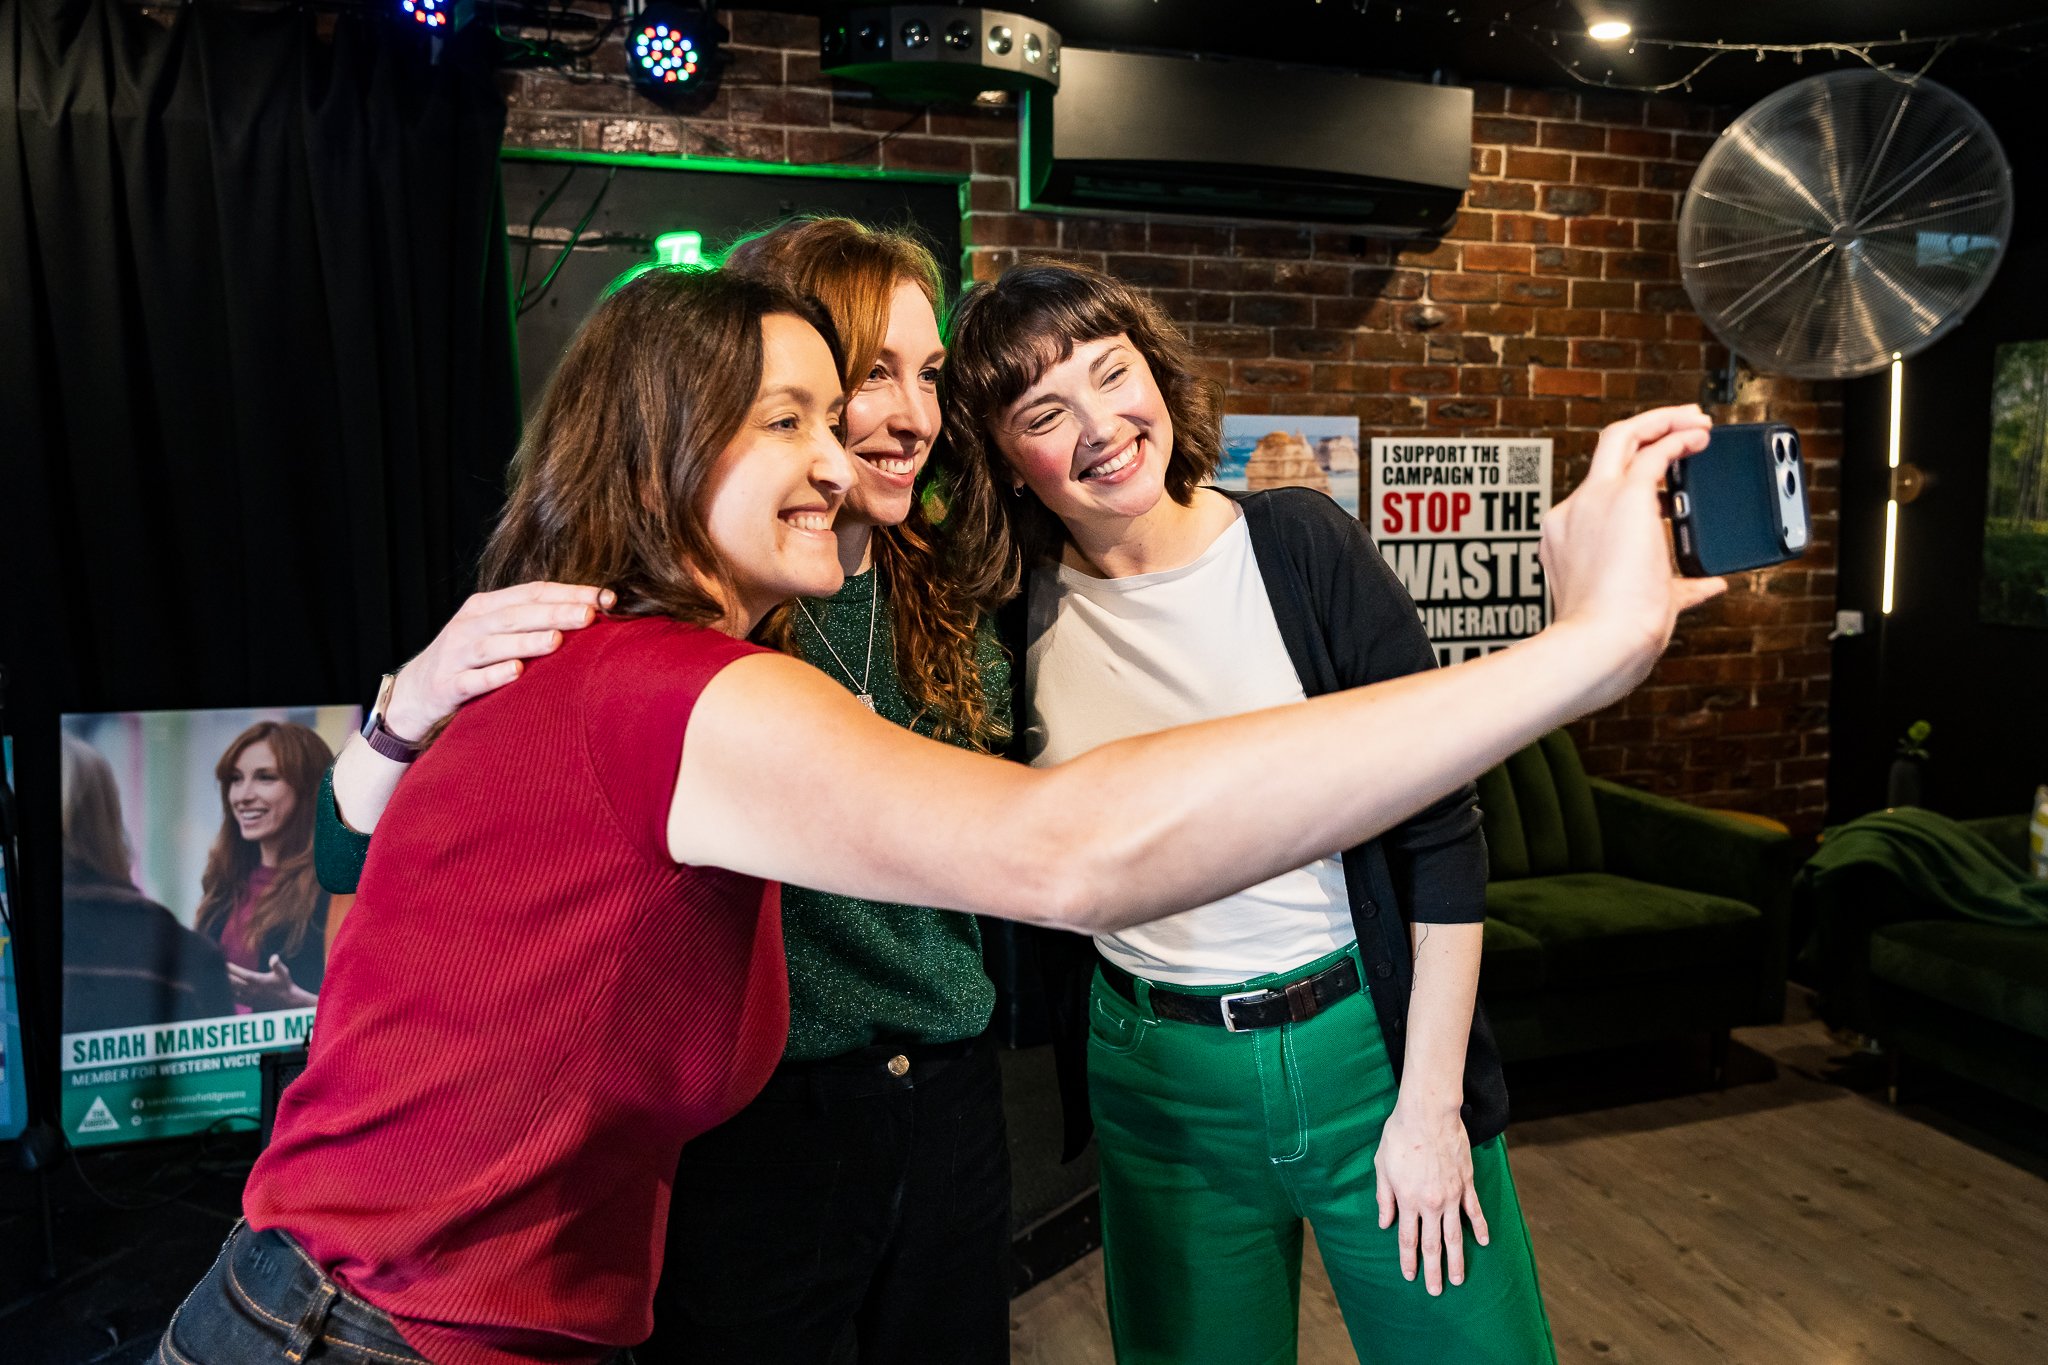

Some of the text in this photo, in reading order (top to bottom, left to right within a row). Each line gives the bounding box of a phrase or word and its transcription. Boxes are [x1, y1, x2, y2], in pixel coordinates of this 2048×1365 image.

[1383, 445, 1500, 463] I SUPPORT THE
[1383, 466, 1500, 486] CAMPAIGN TO
[1382, 491, 1541, 534] STOP THE
[1381, 541, 1542, 601] WASTE
[72, 1033, 146, 1064] SARAH
[155, 1018, 275, 1056] MANSFIELD
[71, 1068, 129, 1087] MEMBER
[131, 1064, 157, 1080] FOR
[160, 1056, 221, 1076] WESTERN
